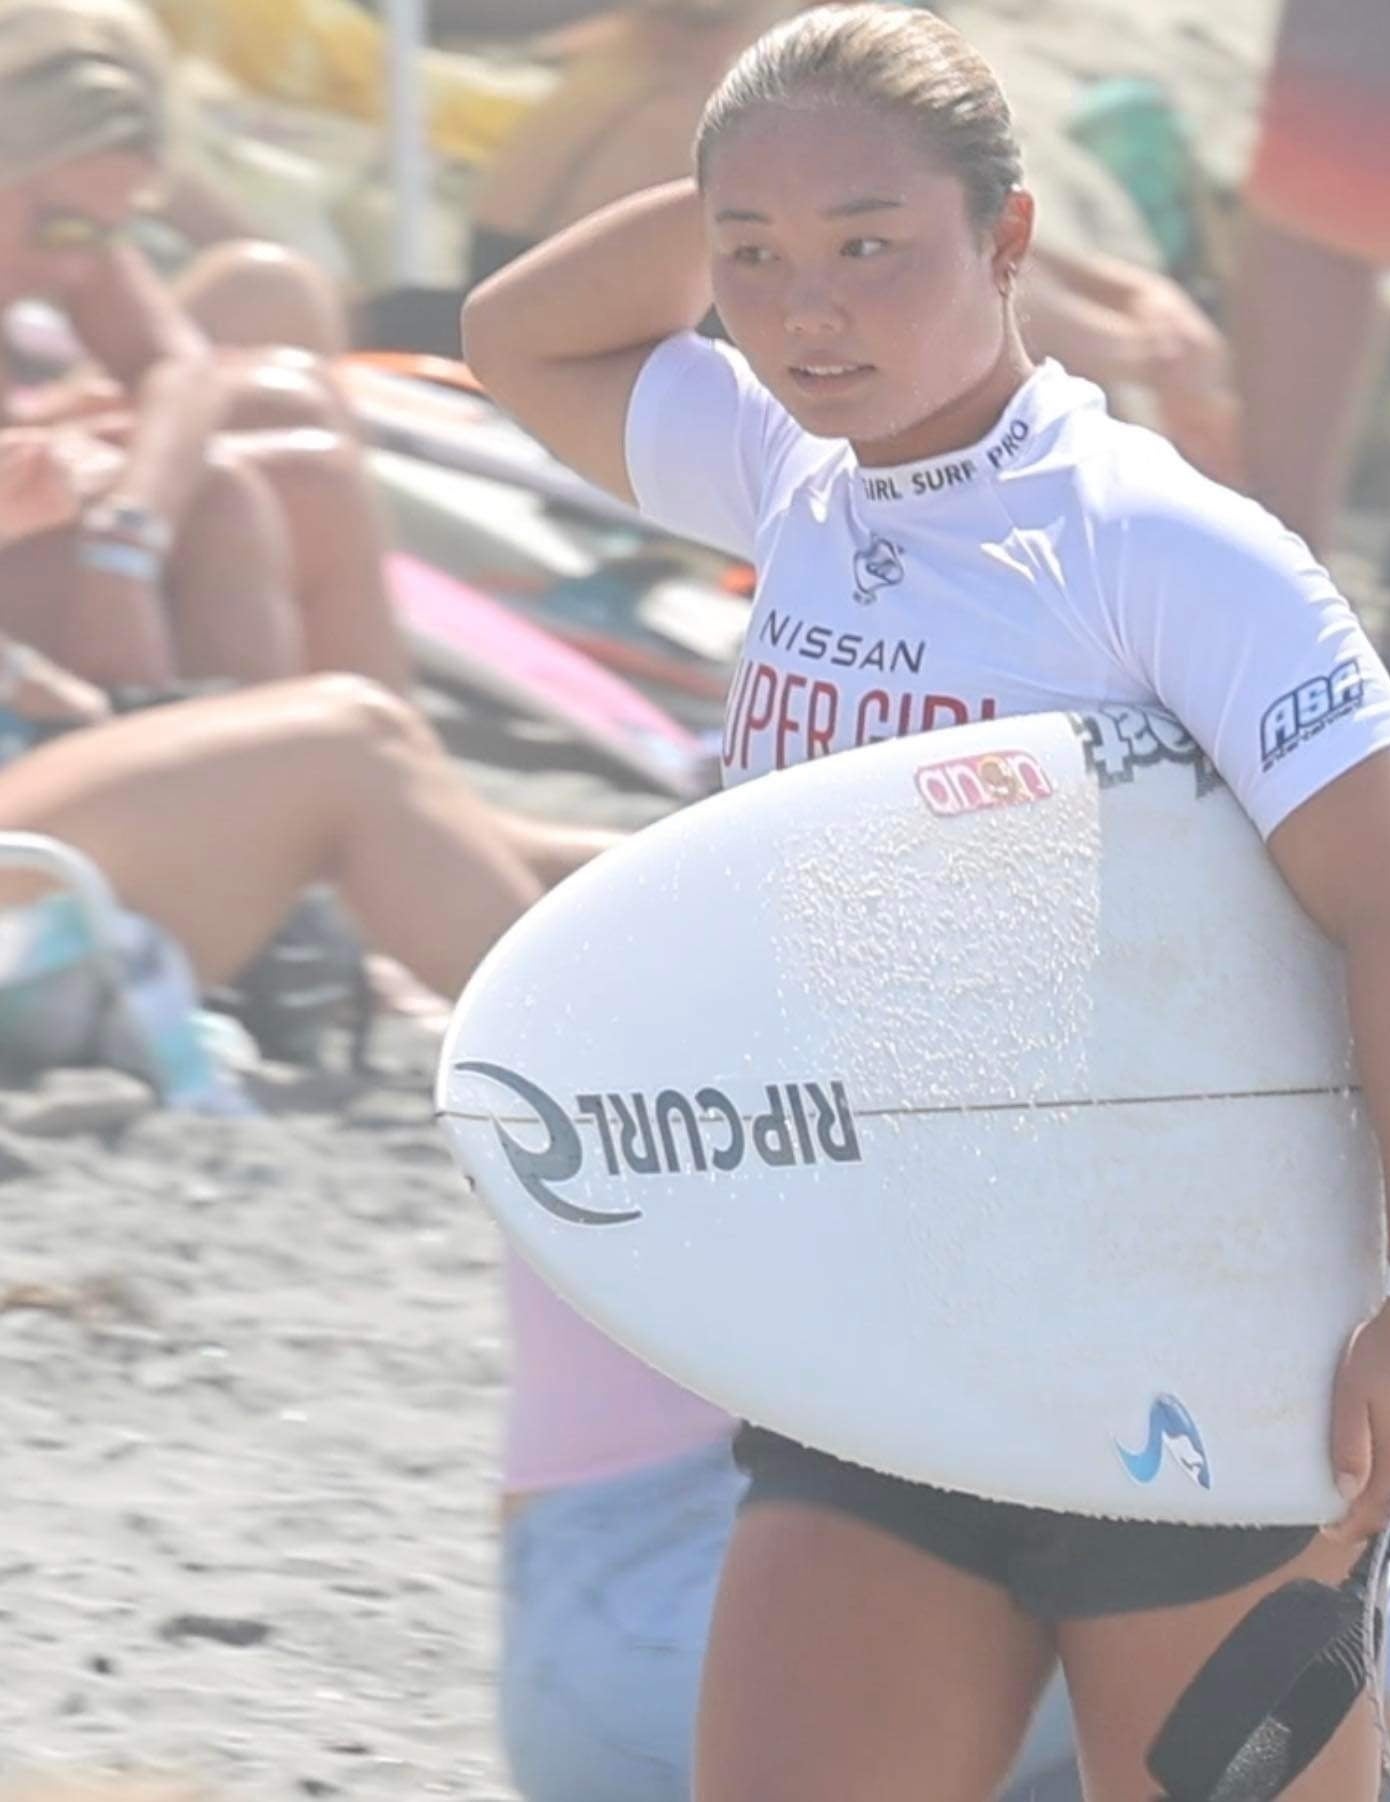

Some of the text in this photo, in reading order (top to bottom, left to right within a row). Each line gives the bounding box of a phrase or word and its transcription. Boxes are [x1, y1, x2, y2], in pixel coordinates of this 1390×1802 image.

[911, 460, 977, 496] SURF
[986, 419, 1029, 469] PRO
[758, 609, 926, 674] NISSAN
[722, 659, 839, 771] UPER
[575, 1079, 863, 1177] RIP CURL
